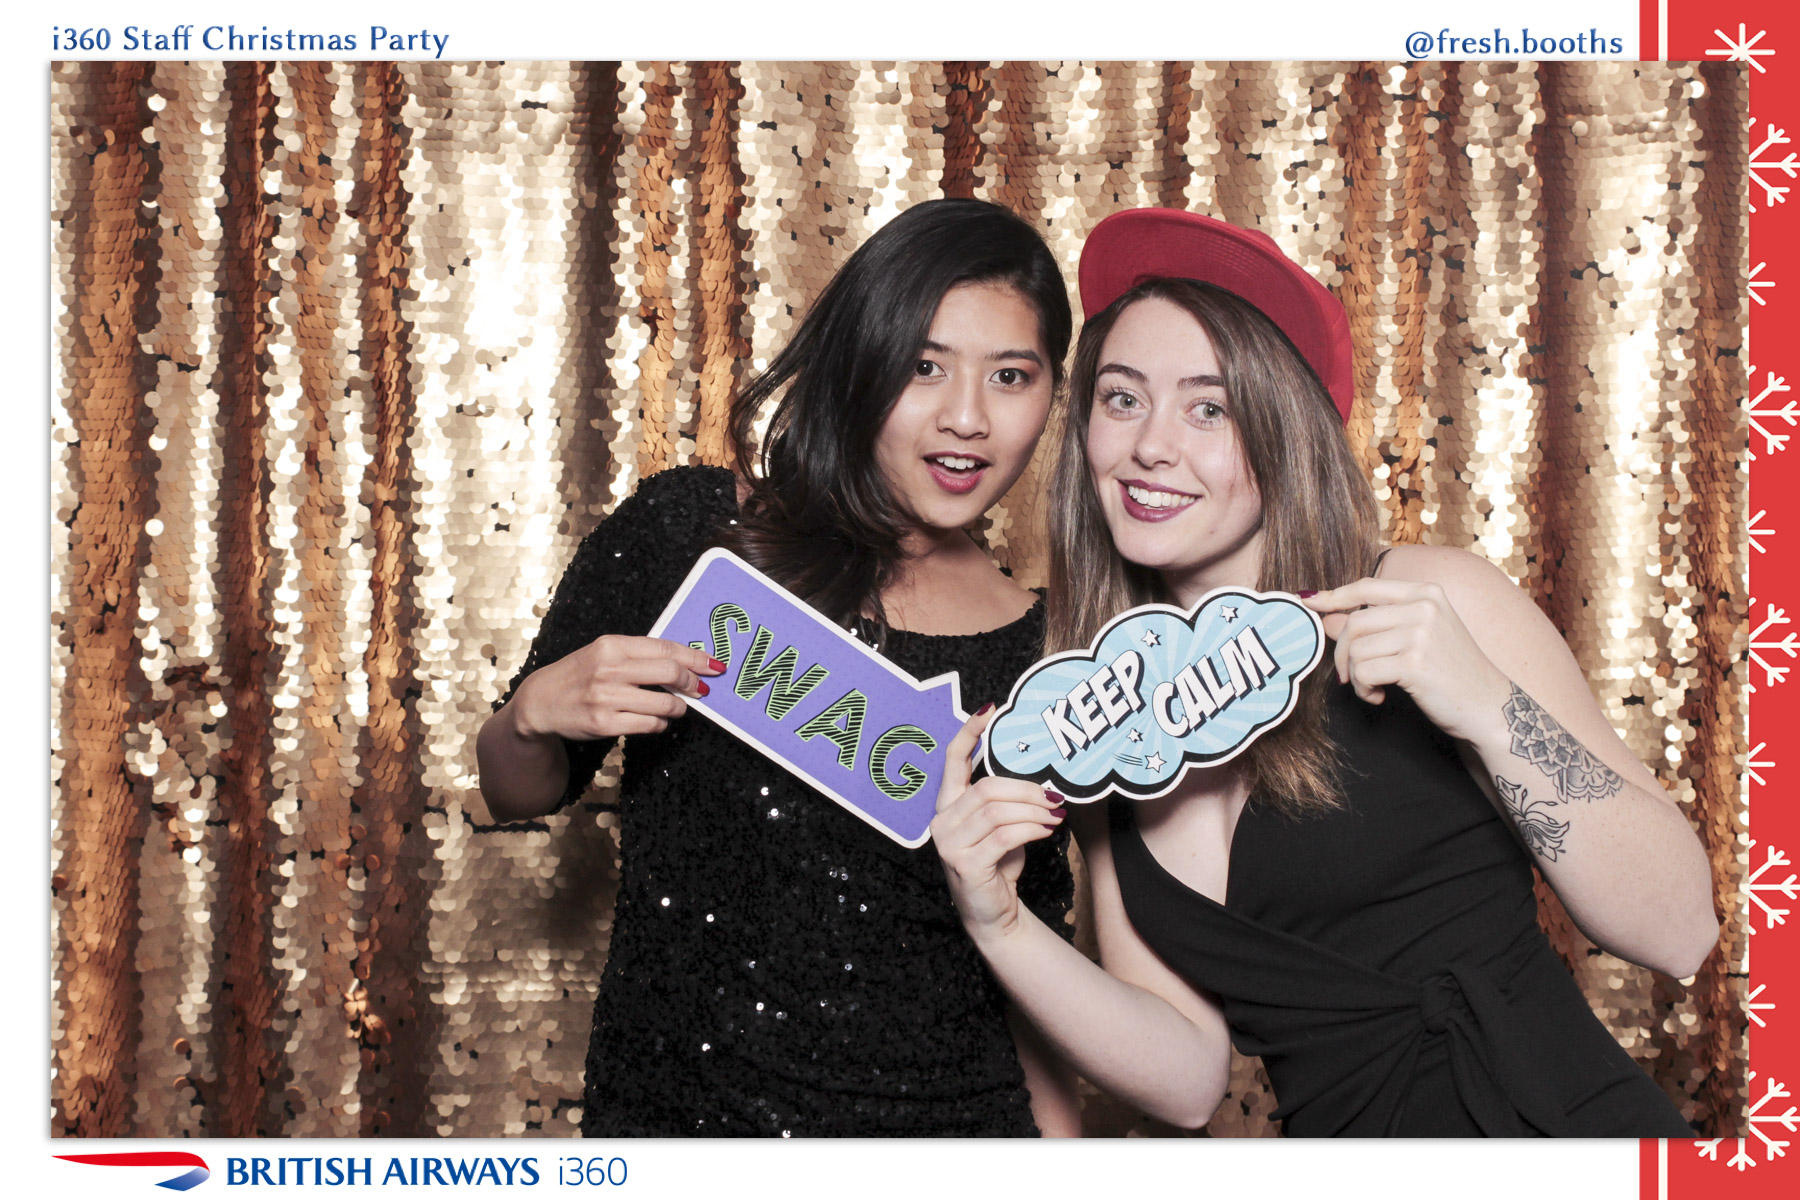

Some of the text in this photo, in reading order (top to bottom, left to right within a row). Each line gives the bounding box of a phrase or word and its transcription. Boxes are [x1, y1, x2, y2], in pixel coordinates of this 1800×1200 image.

[689, 603, 937, 801] SWAG
[1041, 650, 1146, 761] KEEP
[1152, 625, 1281, 738] CALM
